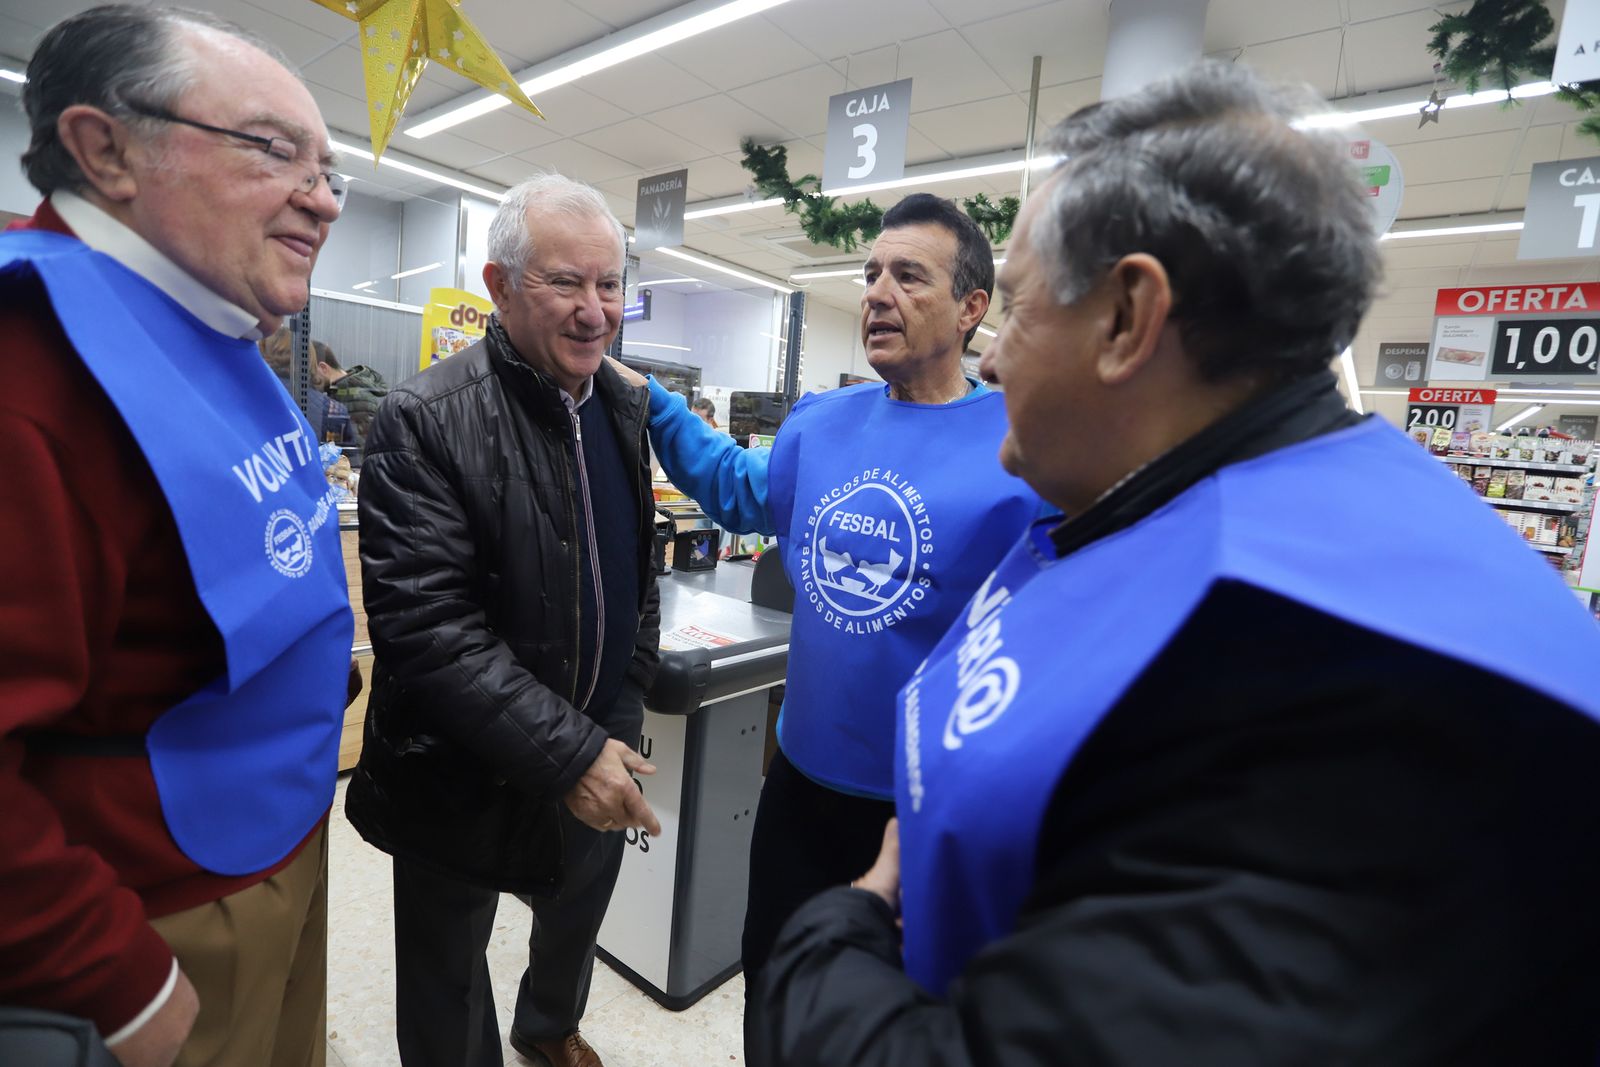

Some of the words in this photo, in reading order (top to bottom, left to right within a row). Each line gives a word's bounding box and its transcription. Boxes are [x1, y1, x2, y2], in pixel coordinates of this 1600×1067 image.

[845, 92, 890, 117] CAJA
[847, 123, 878, 180] 3
[640, 177, 683, 197] PANADERÍA
[1559, 166, 1600, 187] CA
[1457, 286, 1588, 312] OFERTA
[1385, 347, 1426, 356] DESPENSA
[1419, 389, 1483, 403] OFERTA
[808, 475, 860, 527] BANCOS
[862, 468, 880, 482] DE
[881, 470, 934, 554] ALIMENTOS
[829, 510, 900, 543] FESBAL
[801, 546, 824, 613] BANCOS
[824, 611, 843, 630] DE
[845, 576, 931, 635] ALIMENTOS
